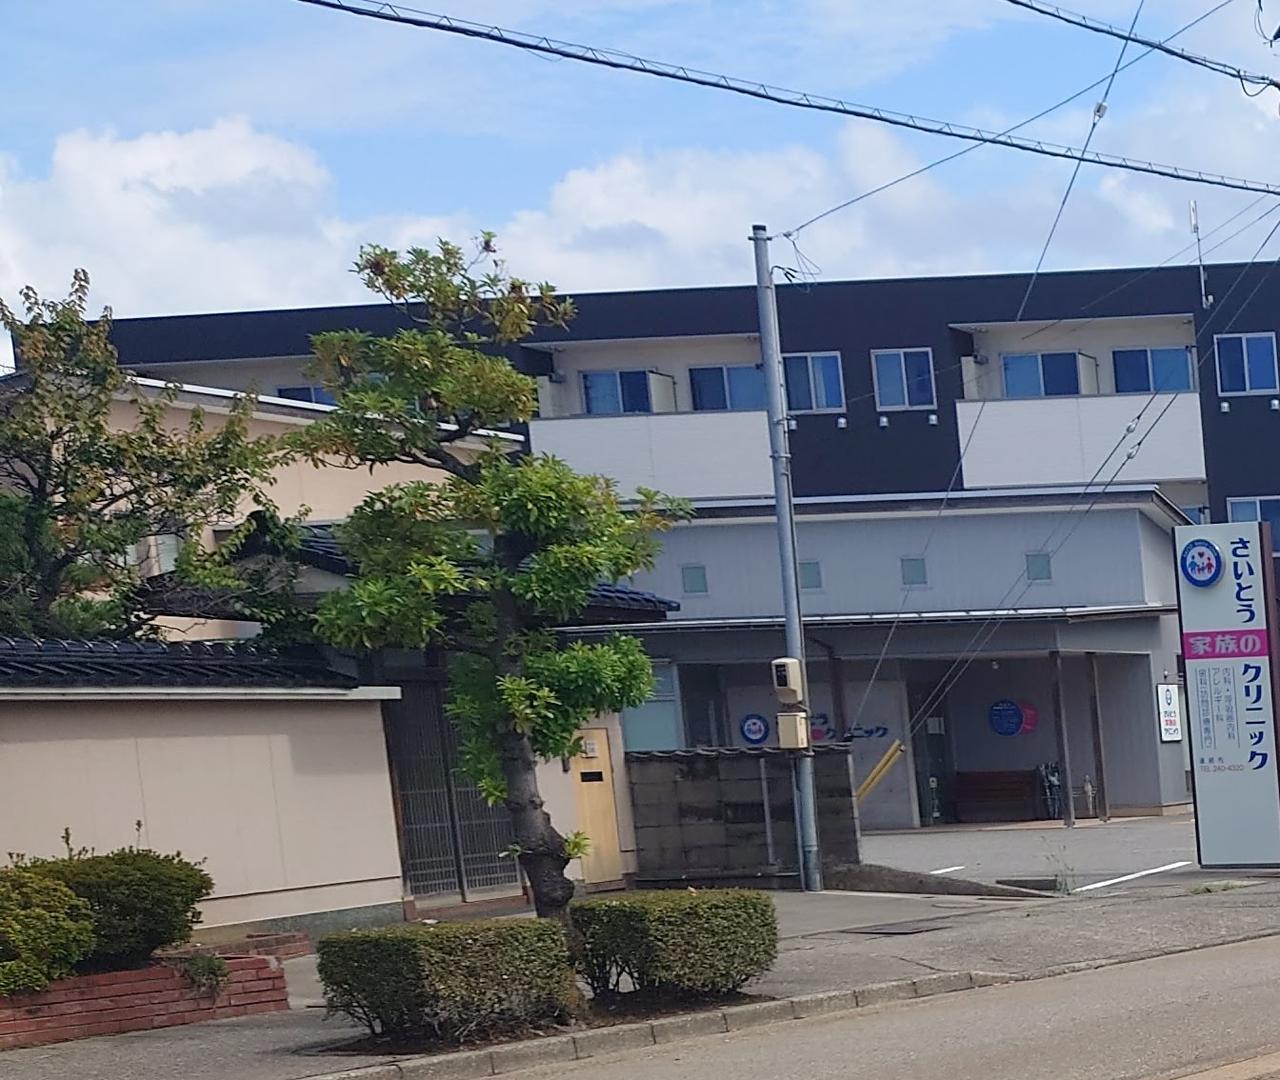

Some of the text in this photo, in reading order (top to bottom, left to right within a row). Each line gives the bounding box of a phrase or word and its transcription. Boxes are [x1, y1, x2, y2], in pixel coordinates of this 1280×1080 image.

[1230, 538, 1256, 624] さいとう
[1190, 635, 1260, 656] 家族の
[1242, 663, 1269, 771] クリニック
